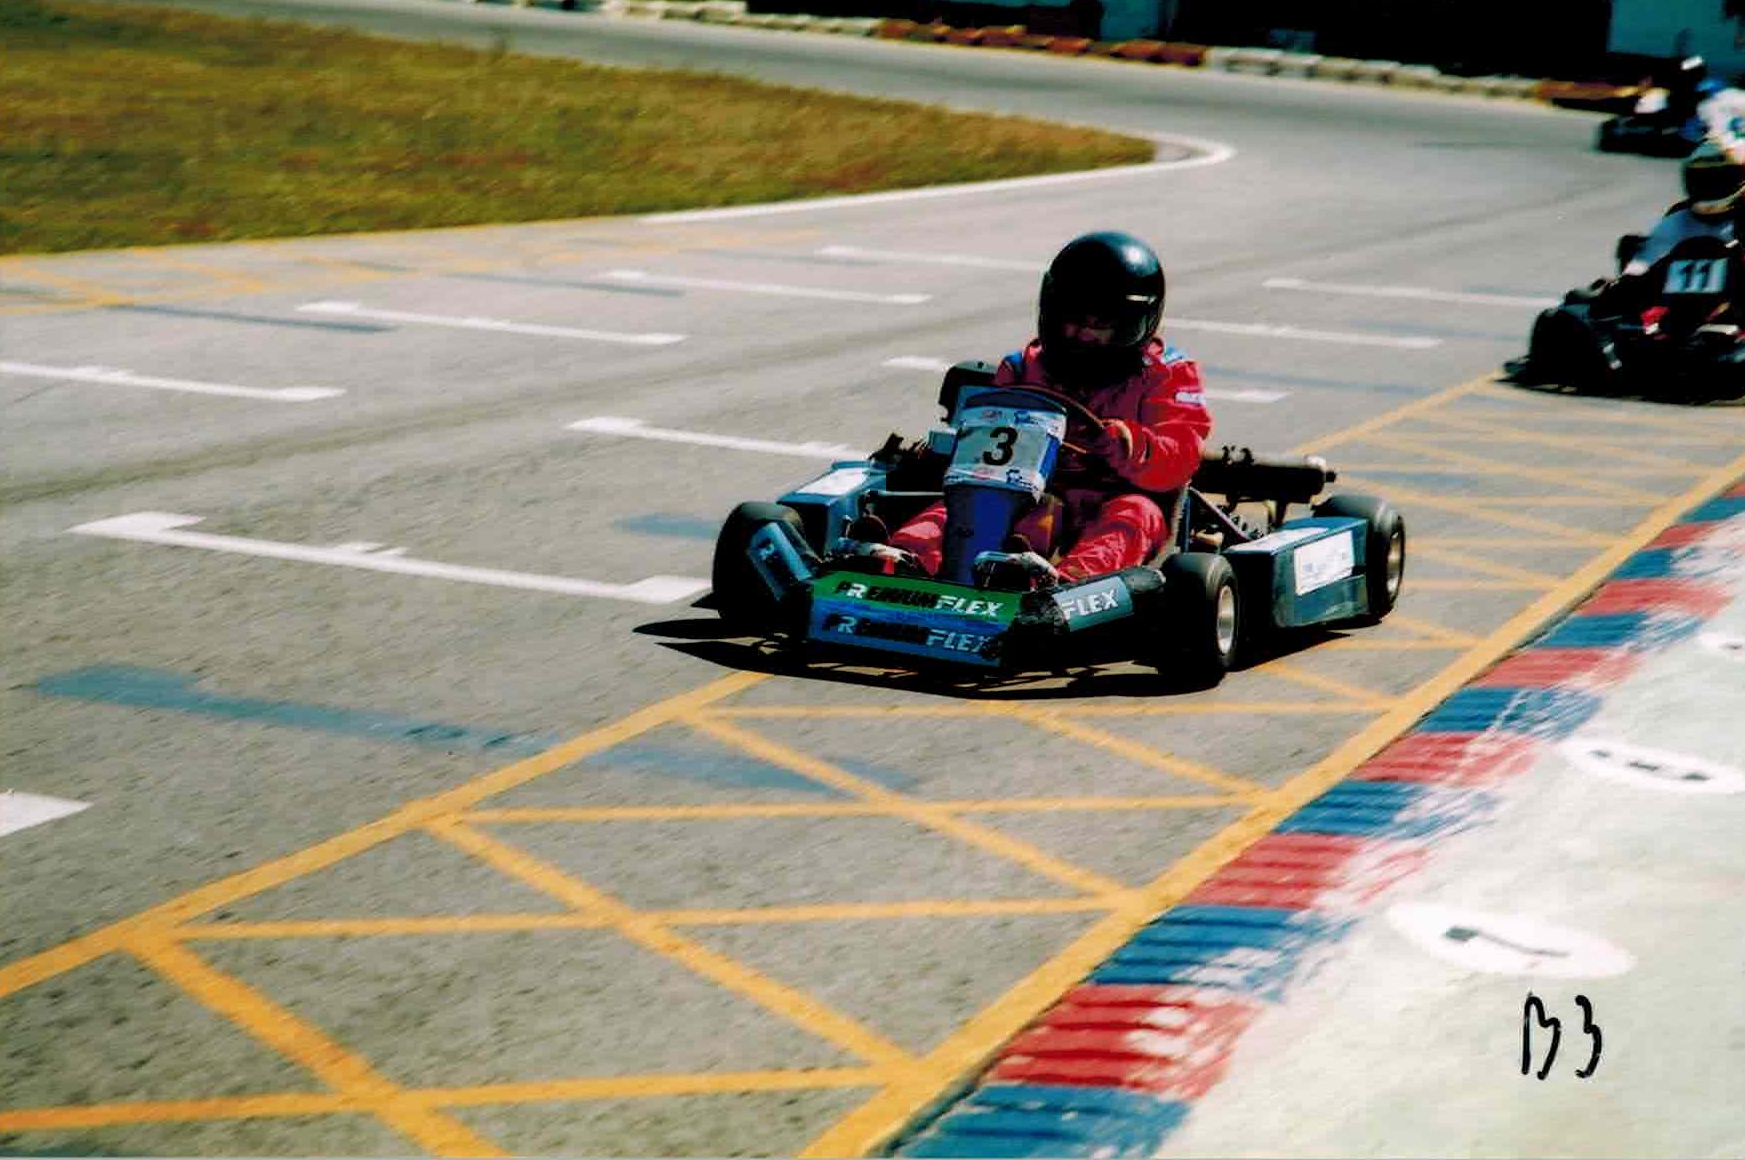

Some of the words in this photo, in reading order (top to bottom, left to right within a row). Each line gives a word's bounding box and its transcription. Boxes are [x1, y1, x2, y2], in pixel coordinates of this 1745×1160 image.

[1678, 261, 1711, 289] 11
[982, 426, 1019, 466] 3
[1061, 588, 1118, 620] FLEX
